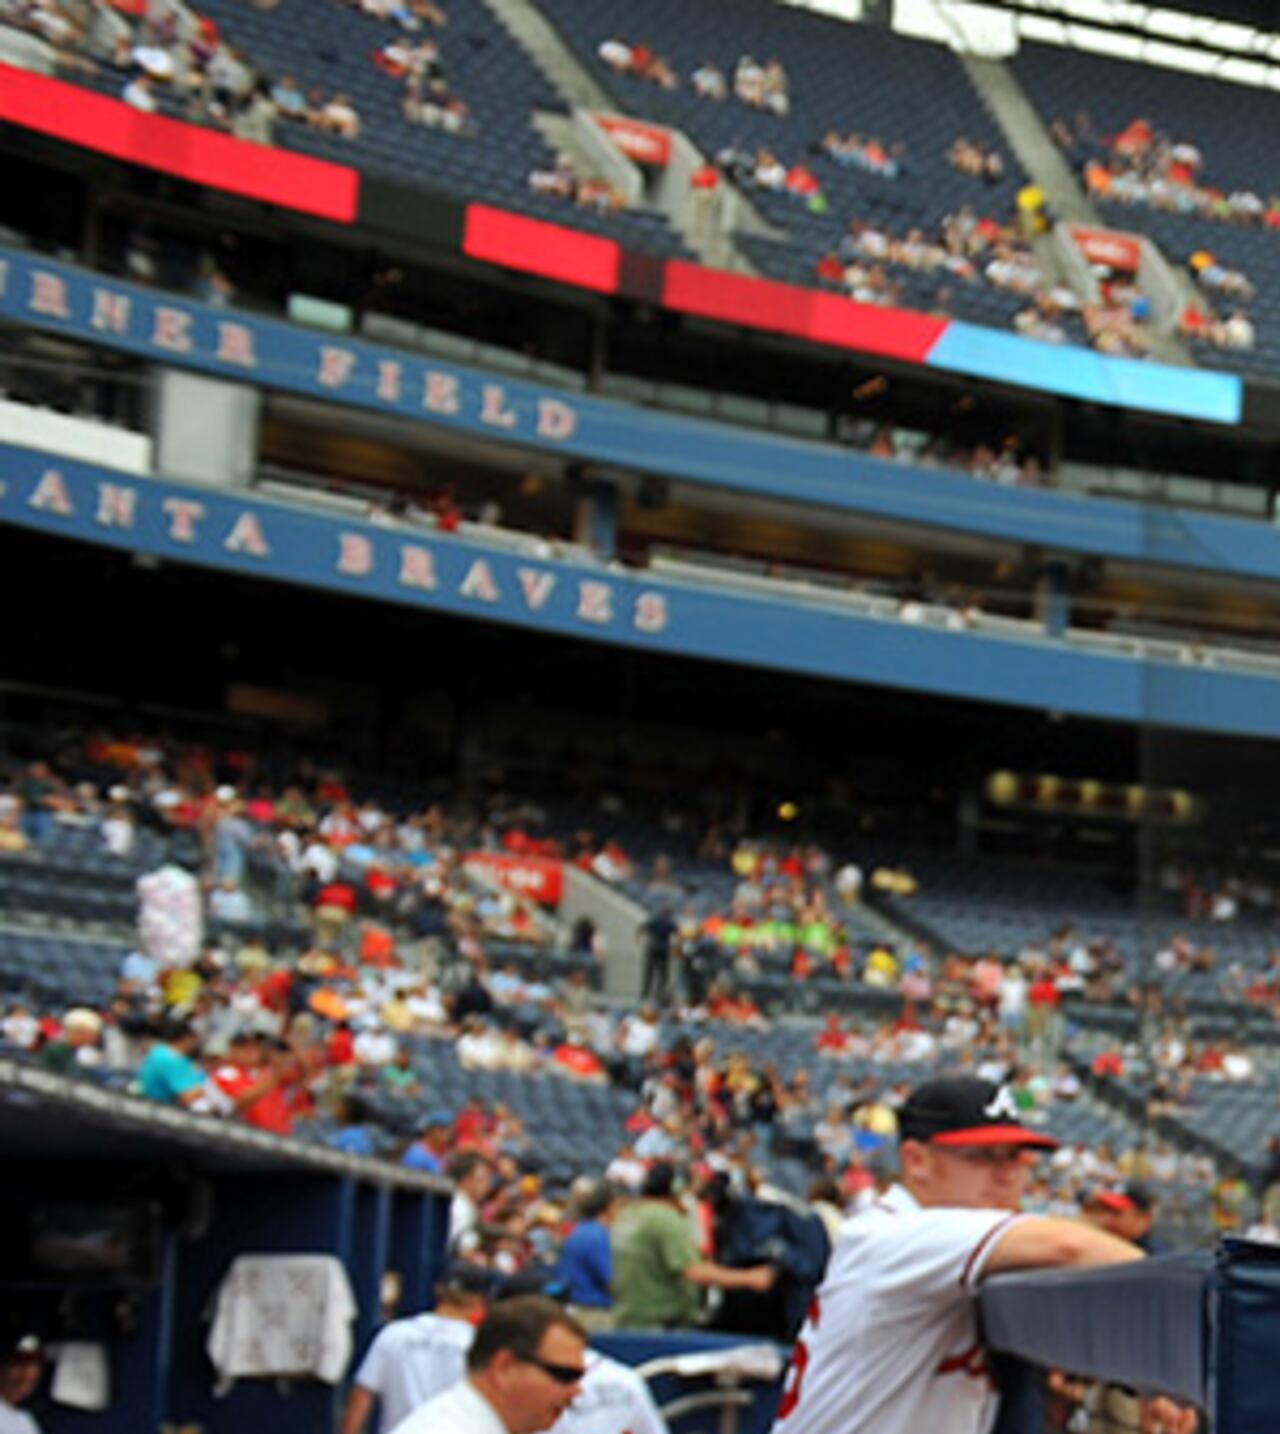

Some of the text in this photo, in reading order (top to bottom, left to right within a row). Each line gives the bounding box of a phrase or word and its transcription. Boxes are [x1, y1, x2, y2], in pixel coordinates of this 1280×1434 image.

[0, 260, 577, 440] RNER FIELD
[0, 469, 669, 632] ANTA BRAVES
